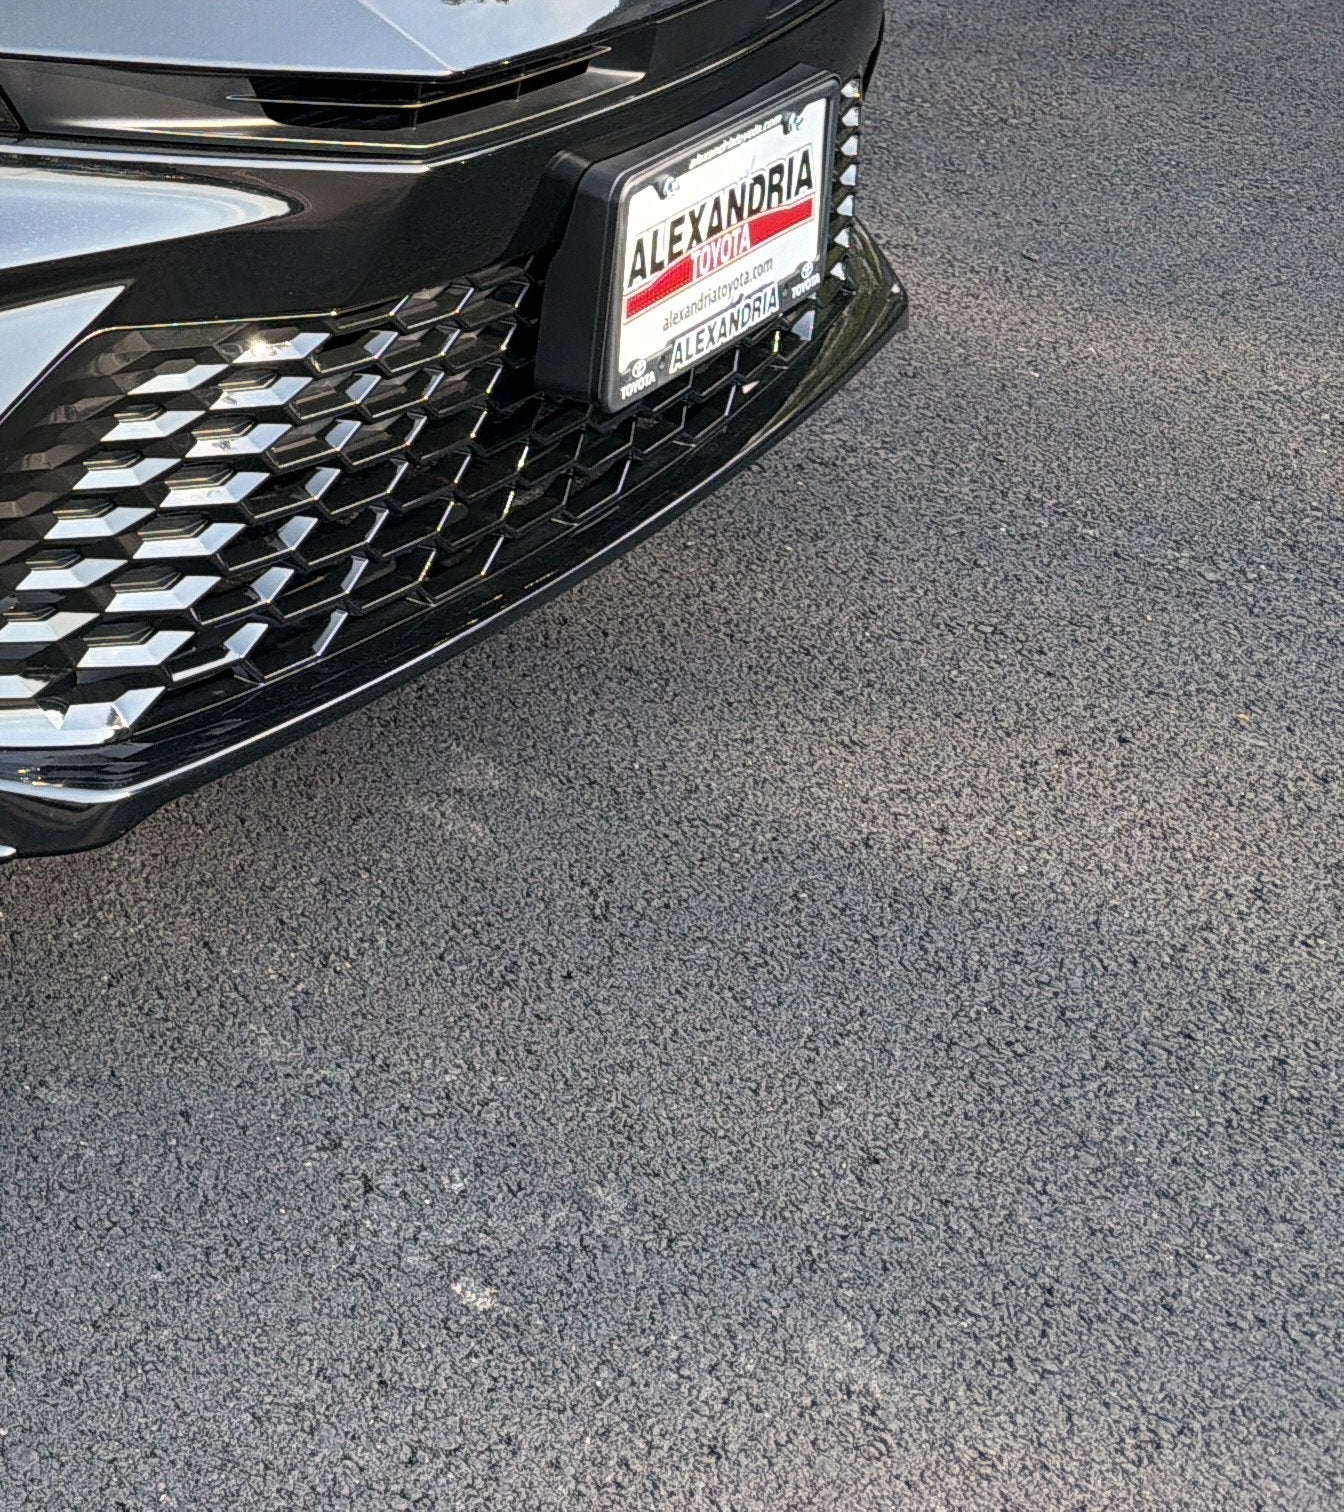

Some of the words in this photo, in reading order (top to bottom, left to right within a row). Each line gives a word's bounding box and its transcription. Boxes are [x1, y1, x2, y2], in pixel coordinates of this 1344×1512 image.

[628, 149, 814, 288] ALEXANDRIA
[690, 222, 751, 278] TOYOTA
[662, 256, 774, 330] alexandriatoyota.com
[791, 272, 821, 300] TOYOTA
[672, 286, 778, 367] ALEXANDRIA
[620, 370, 656, 400] TOYOTA
